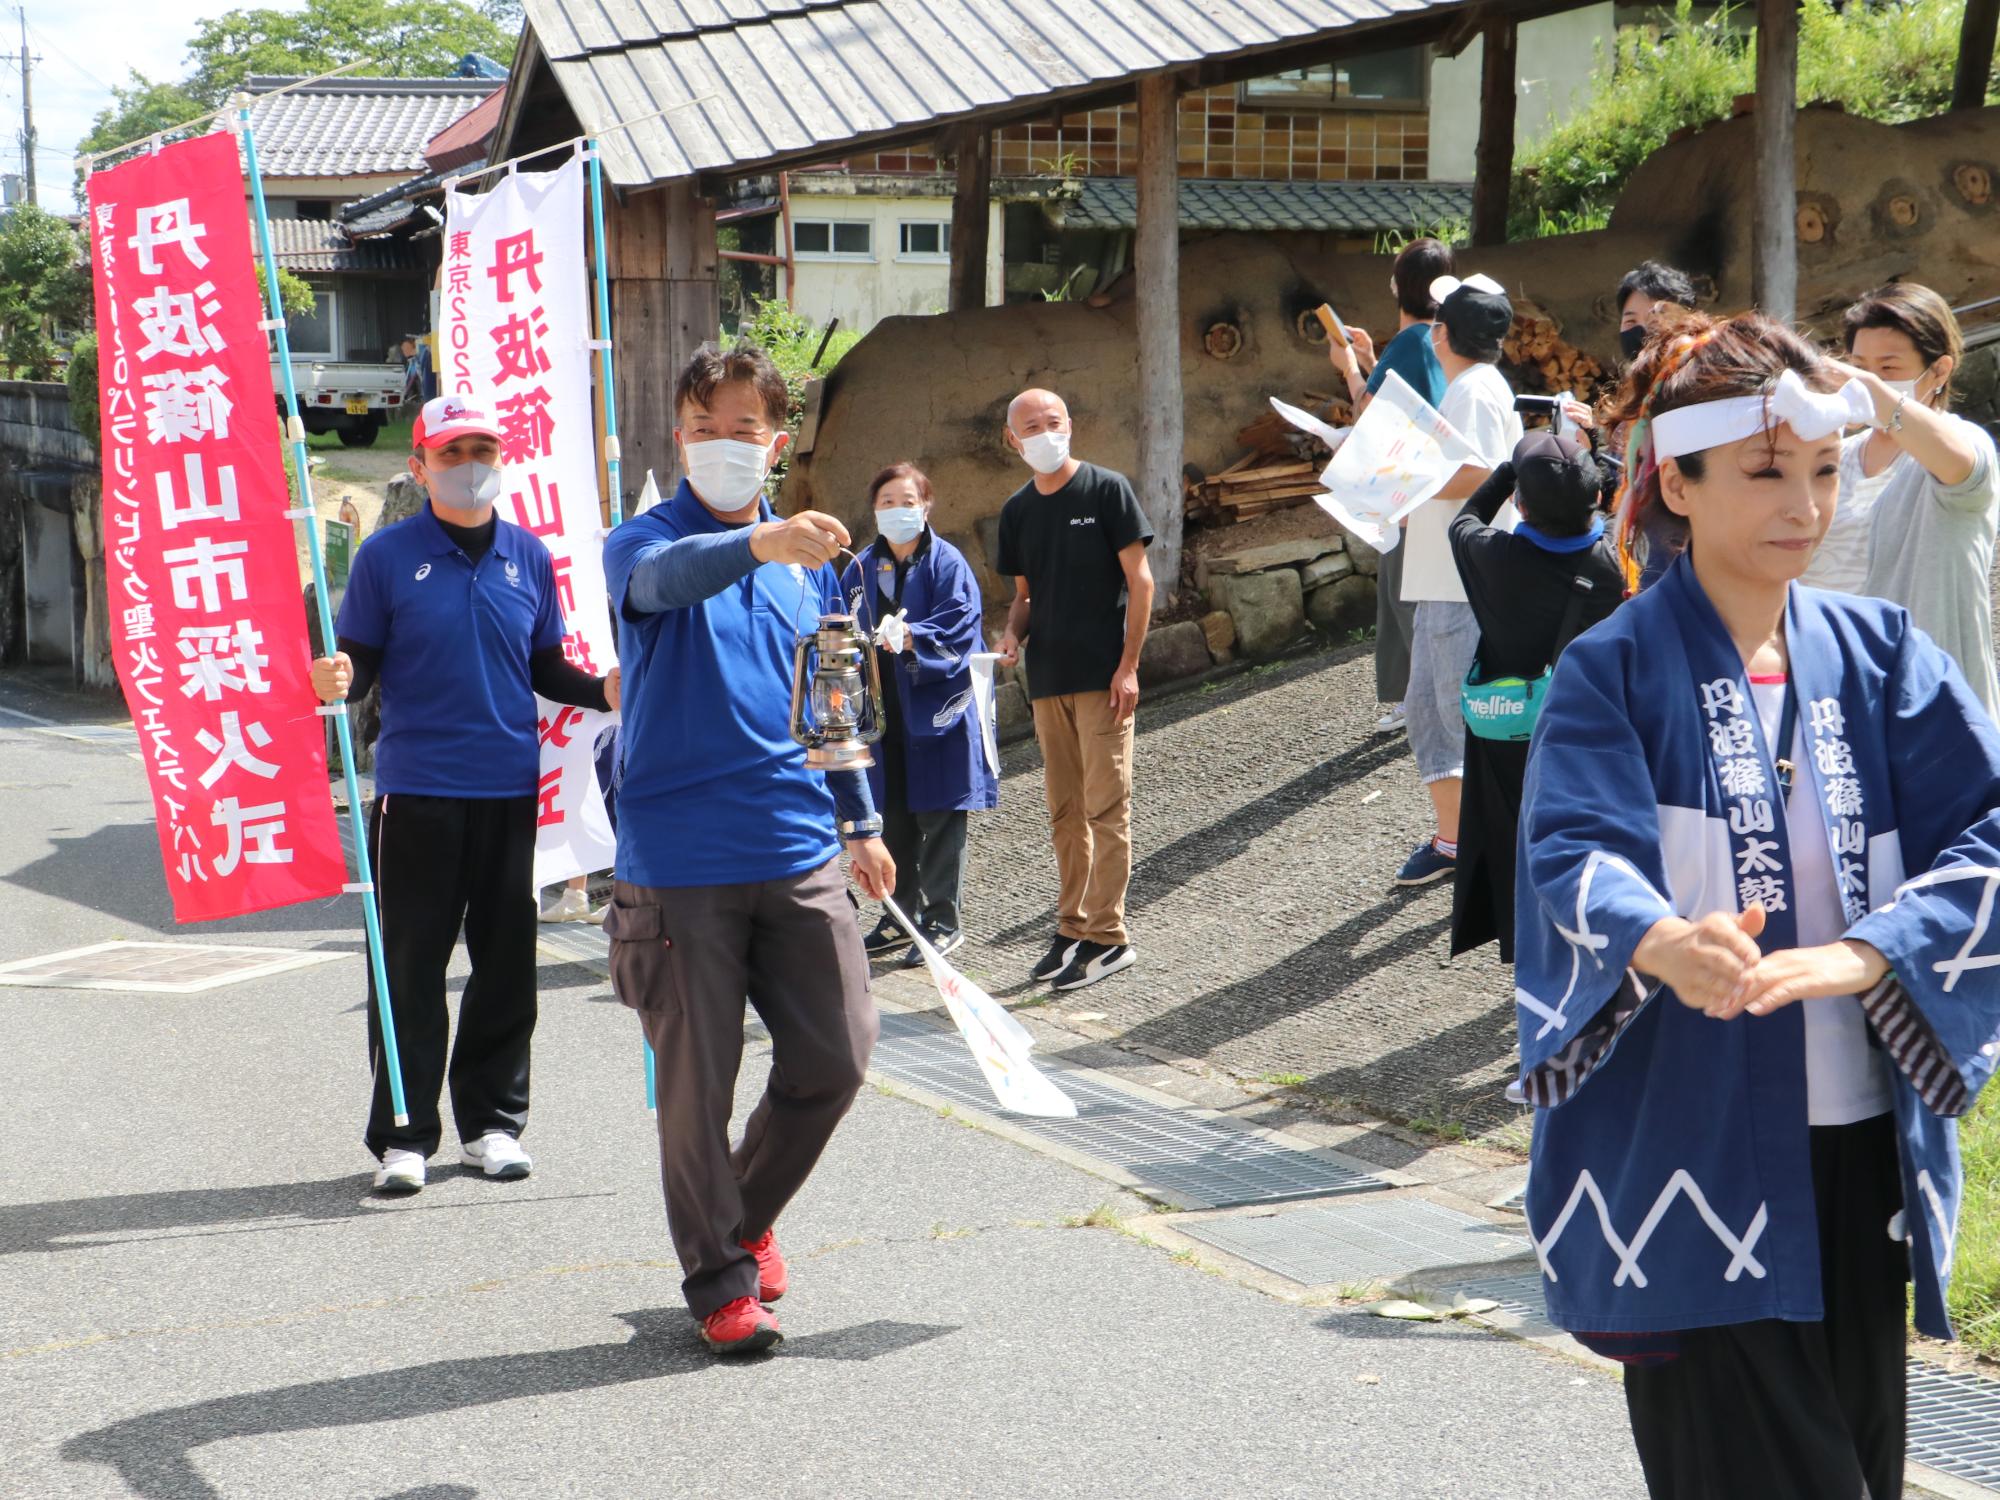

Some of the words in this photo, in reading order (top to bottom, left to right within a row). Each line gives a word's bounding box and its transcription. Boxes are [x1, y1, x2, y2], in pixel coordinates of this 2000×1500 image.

[1700, 677, 1788, 913] 丹波篠山太鼓
